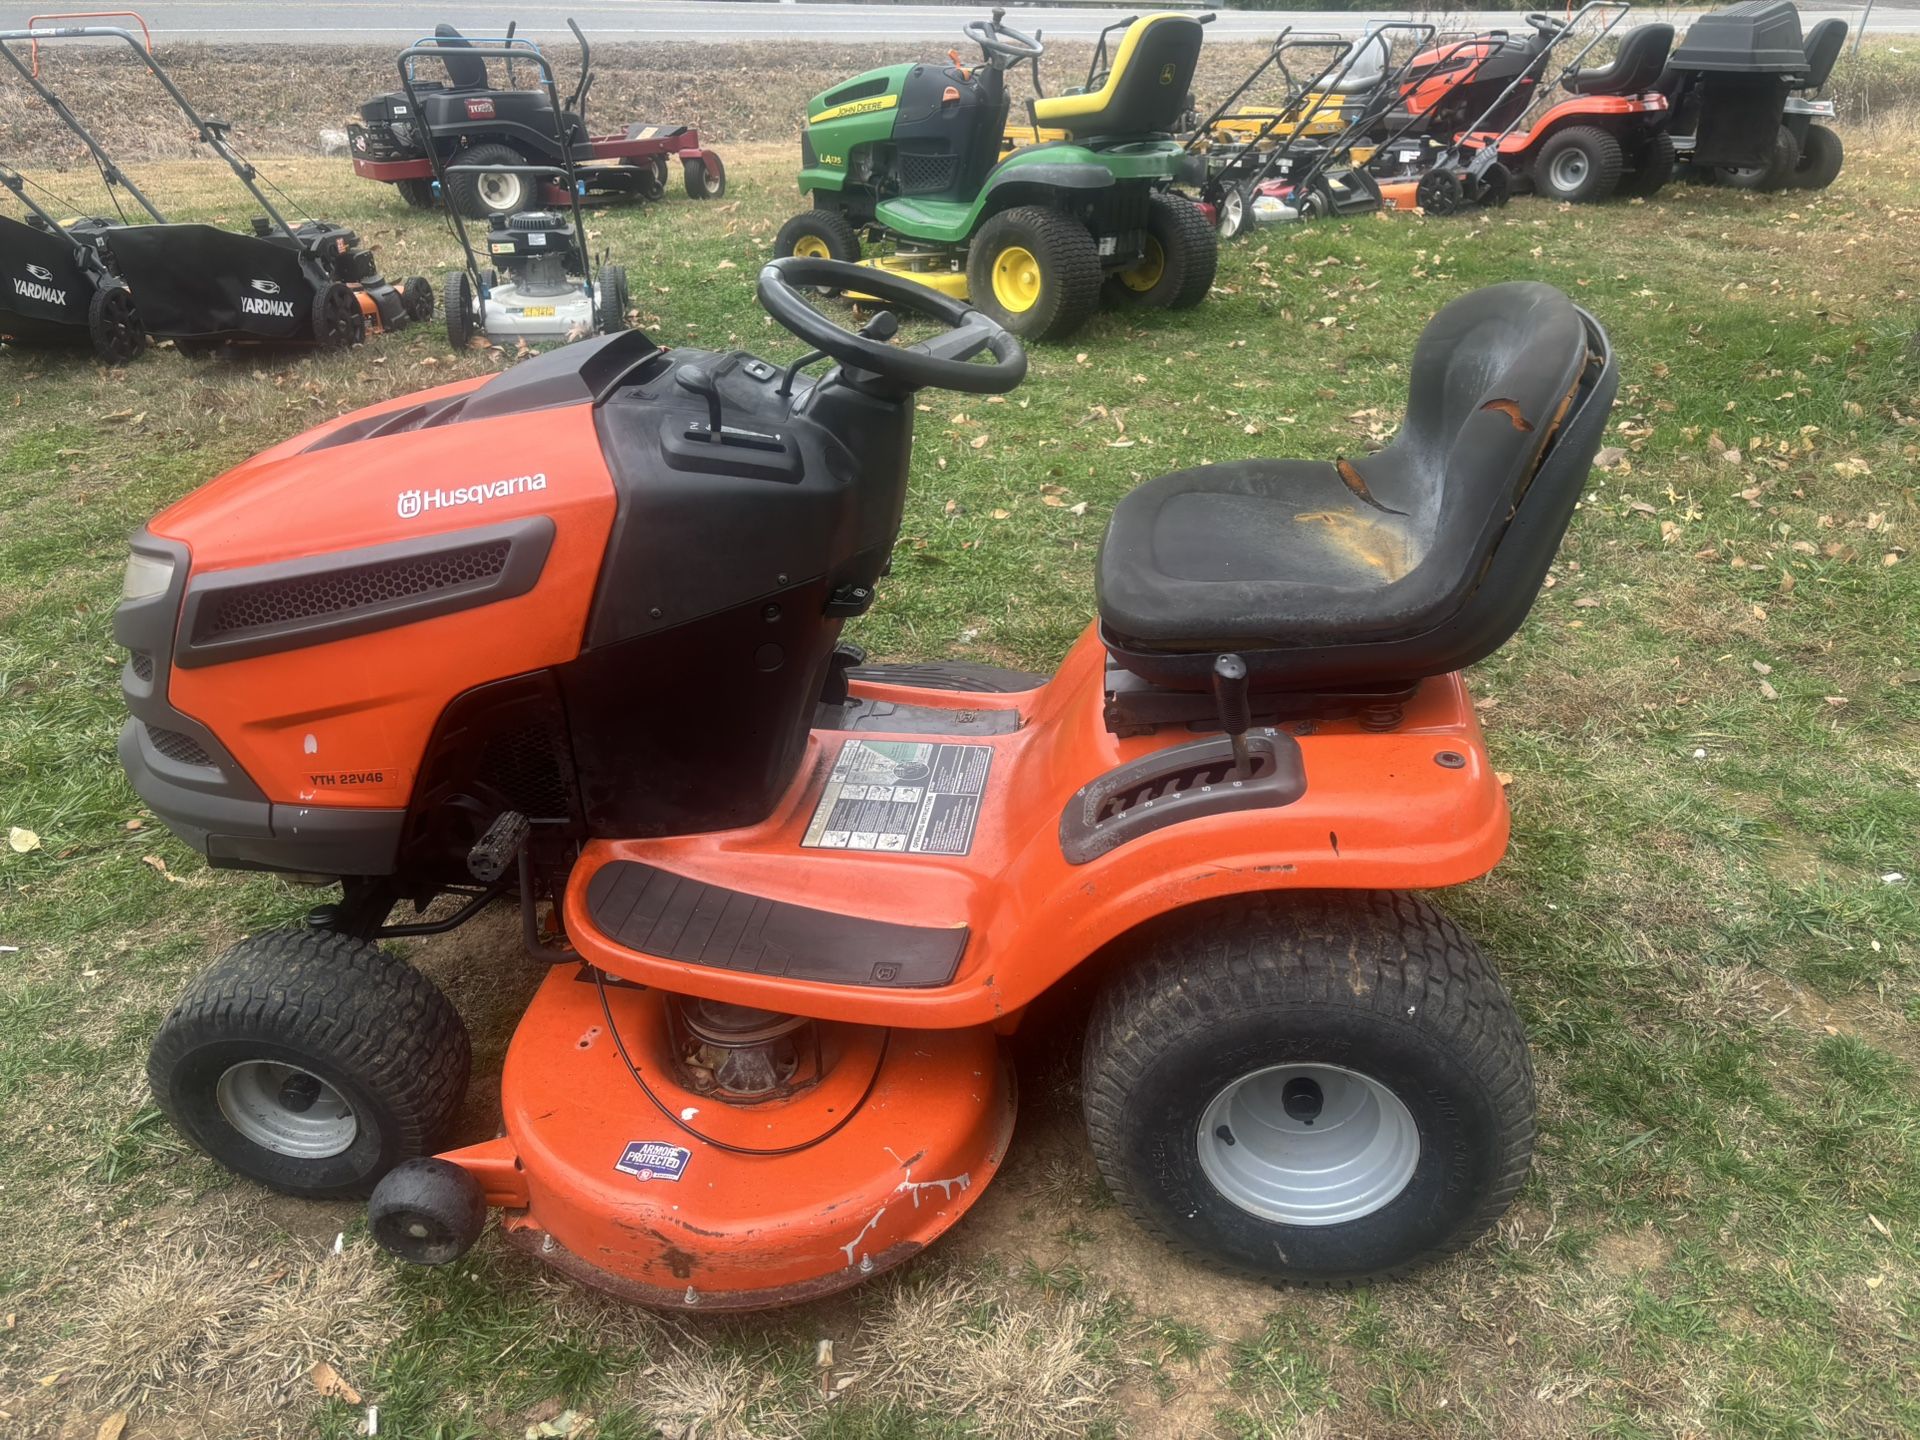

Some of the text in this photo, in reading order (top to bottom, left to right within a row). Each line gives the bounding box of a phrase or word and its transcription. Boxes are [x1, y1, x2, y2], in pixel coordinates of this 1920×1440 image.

[837, 101, 883, 117] JOHN DEERE
[13, 277, 66, 306] YARDMAX
[241, 296, 294, 317] YARDMAX
[423, 472, 547, 511] Husqvarna
[310, 772, 384, 786] YTH 22V46
[1118, 811, 1127, 819] 2
[1201, 785, 1211, 793] 5
[1232, 780, 1243, 788] 6
[912, 824, 925, 848] OPERATING
[919, 795, 934, 825] INSTRUCTIONS
[625, 1151, 680, 1169] PROTECTED
[640, 1143, 674, 1157] ARMOR
